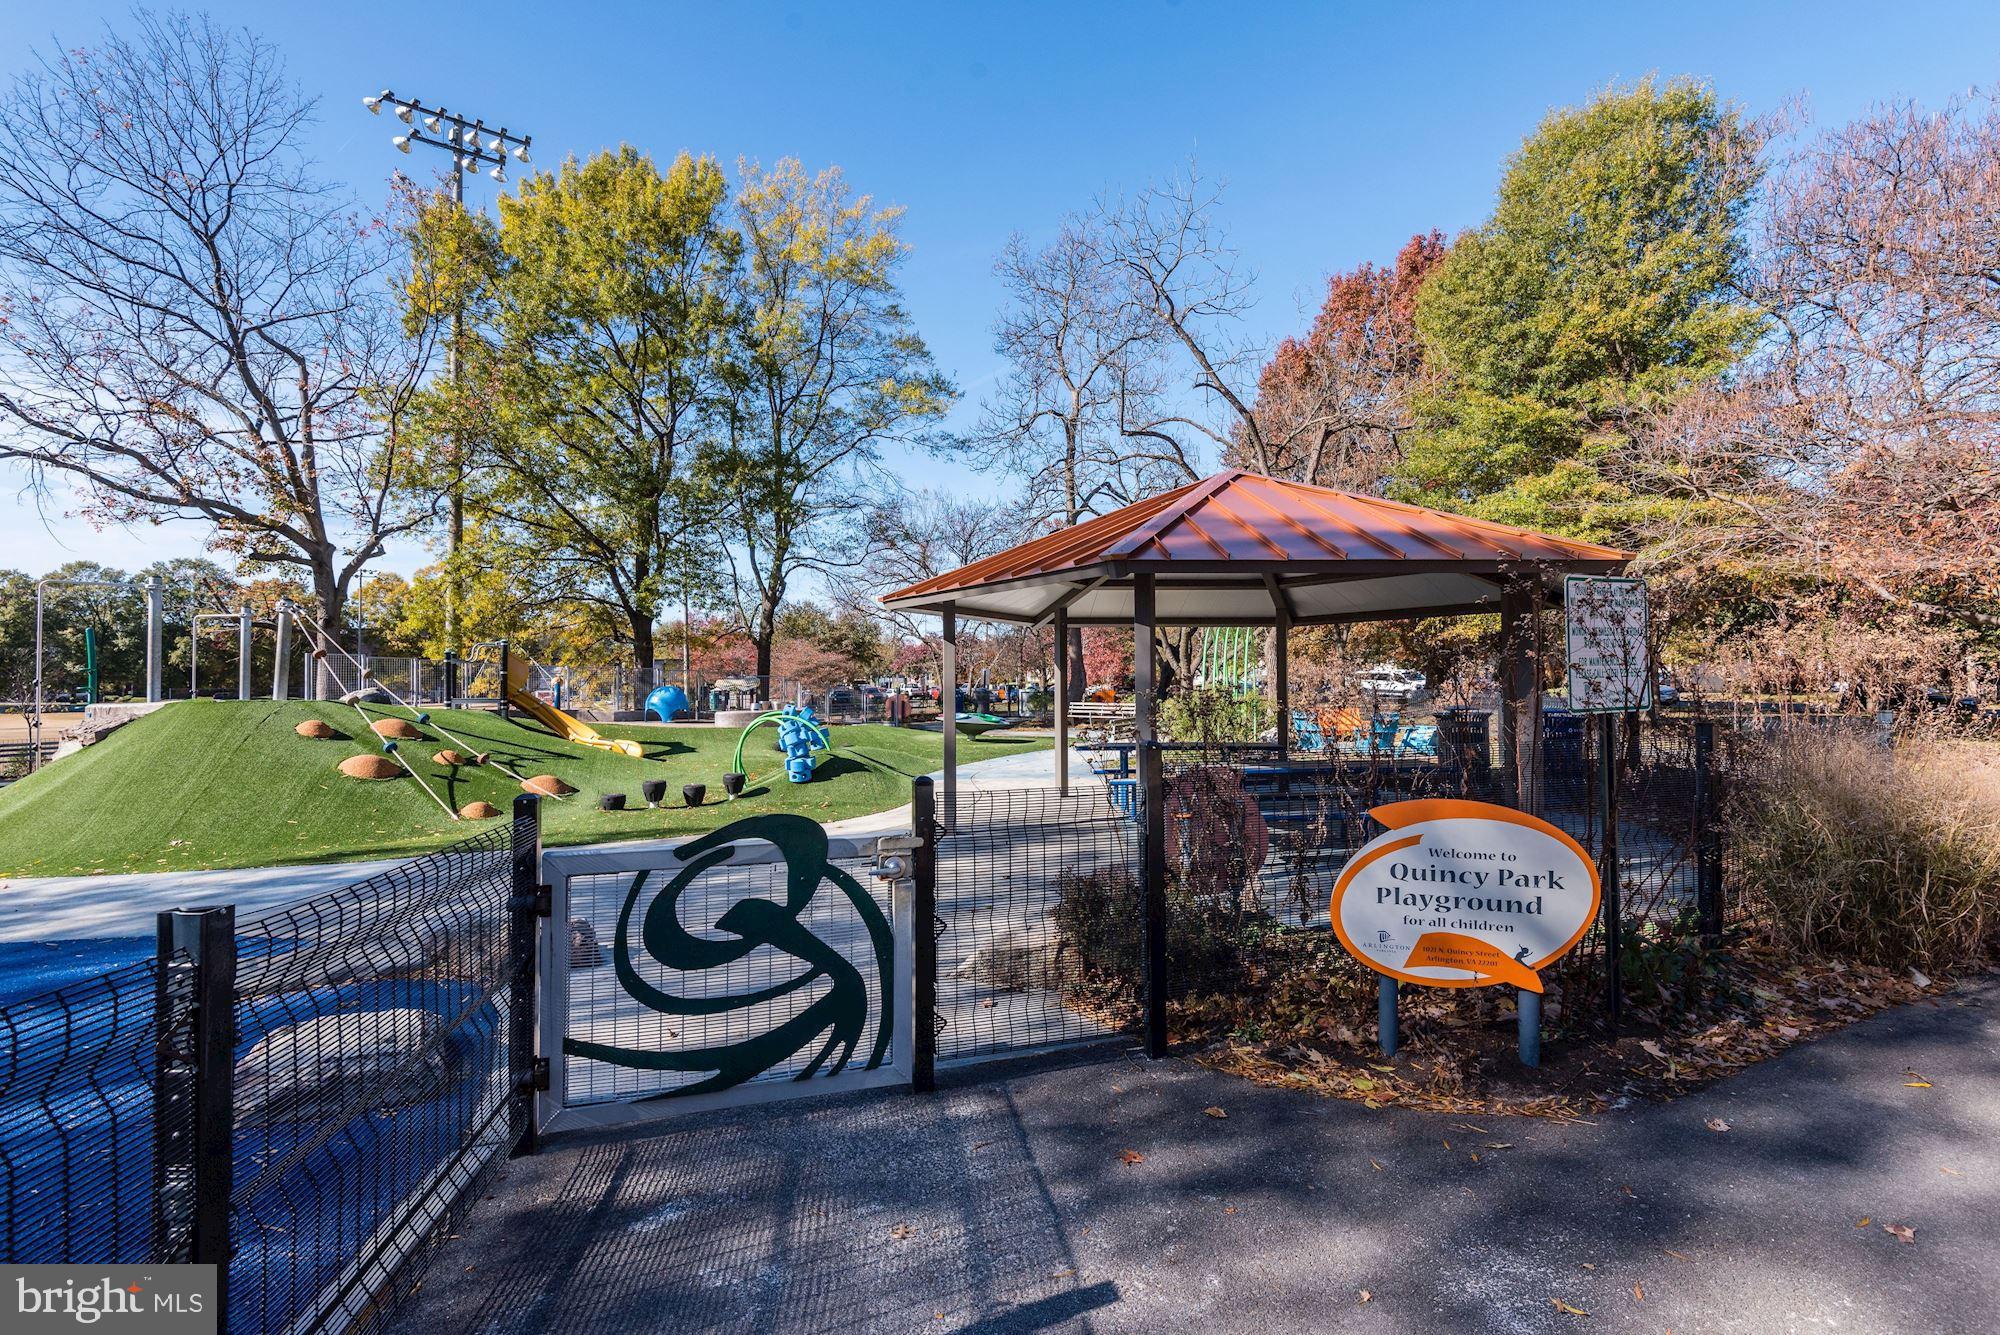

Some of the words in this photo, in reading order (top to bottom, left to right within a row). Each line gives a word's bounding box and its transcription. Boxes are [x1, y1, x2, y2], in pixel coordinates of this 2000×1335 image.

[1429, 848, 1496, 861] Welcome
[1501, 852, 1517, 862] to
[1390, 862, 1490, 889] Quincy
[1498, 868, 1566, 890] Park
[1376, 886, 1544, 915] Playground
[1403, 915, 1425, 926] for
[1428, 917, 1447, 928] all
[1450, 918, 1514, 933] children
[1362, 943, 1411, 951] ARLINGTON
[1447, 947, 1474, 956] Quincy
[1475, 950, 1500, 958] Street
